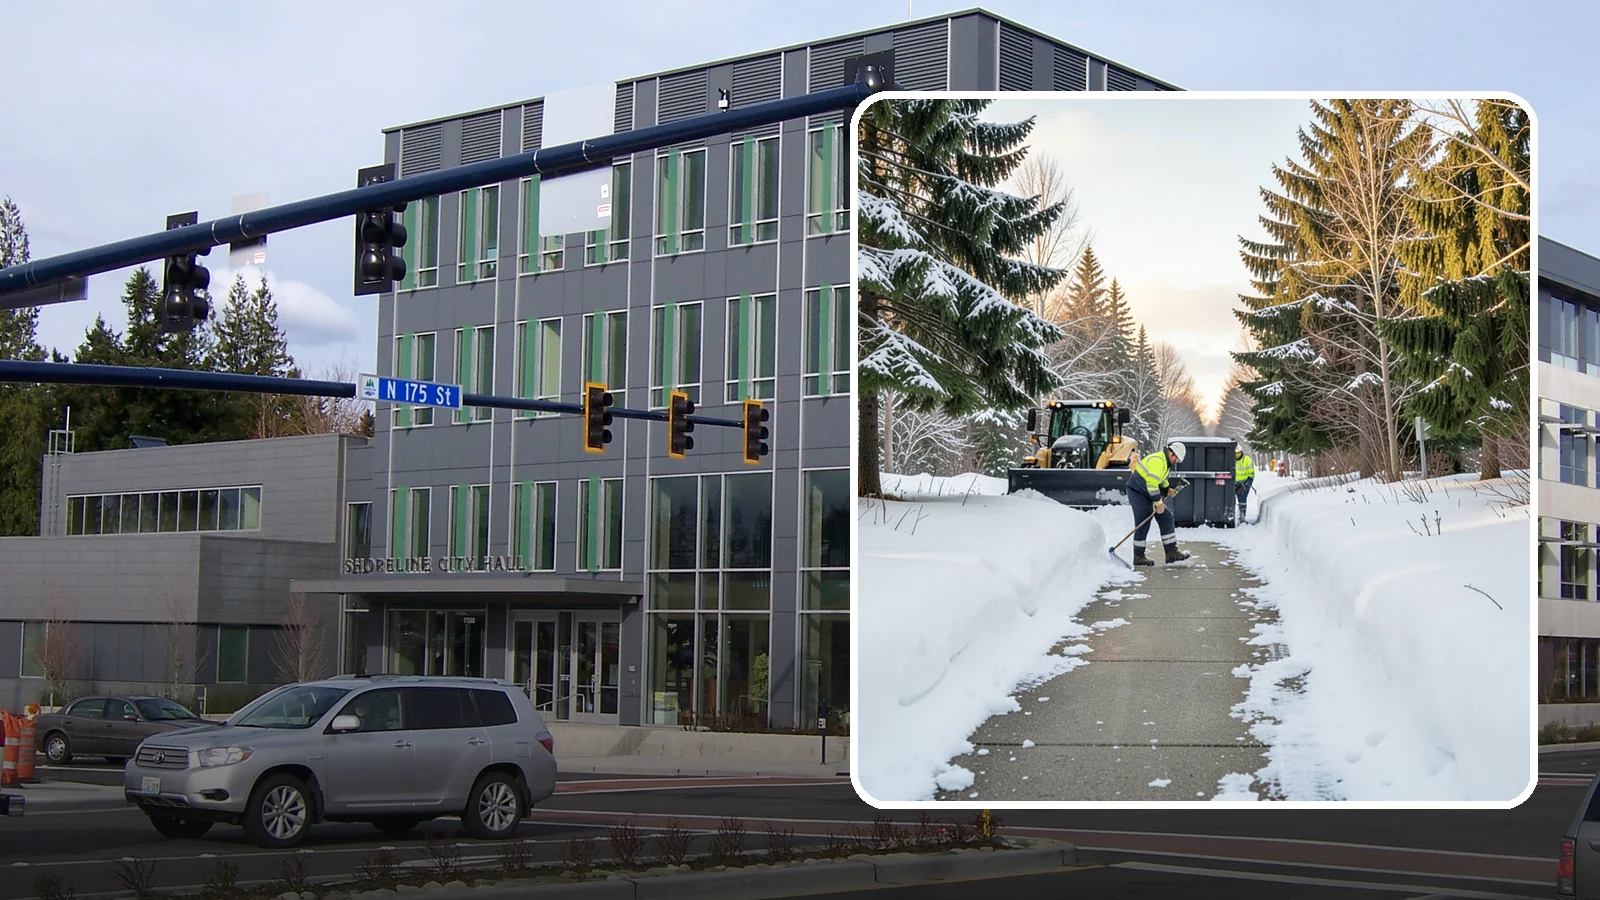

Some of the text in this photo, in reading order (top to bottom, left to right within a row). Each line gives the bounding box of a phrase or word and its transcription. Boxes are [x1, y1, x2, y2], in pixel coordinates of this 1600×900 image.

[387, 380, 451, 405] N 175 St
[344, 555, 526, 573] SHORELINE CITY HALL
